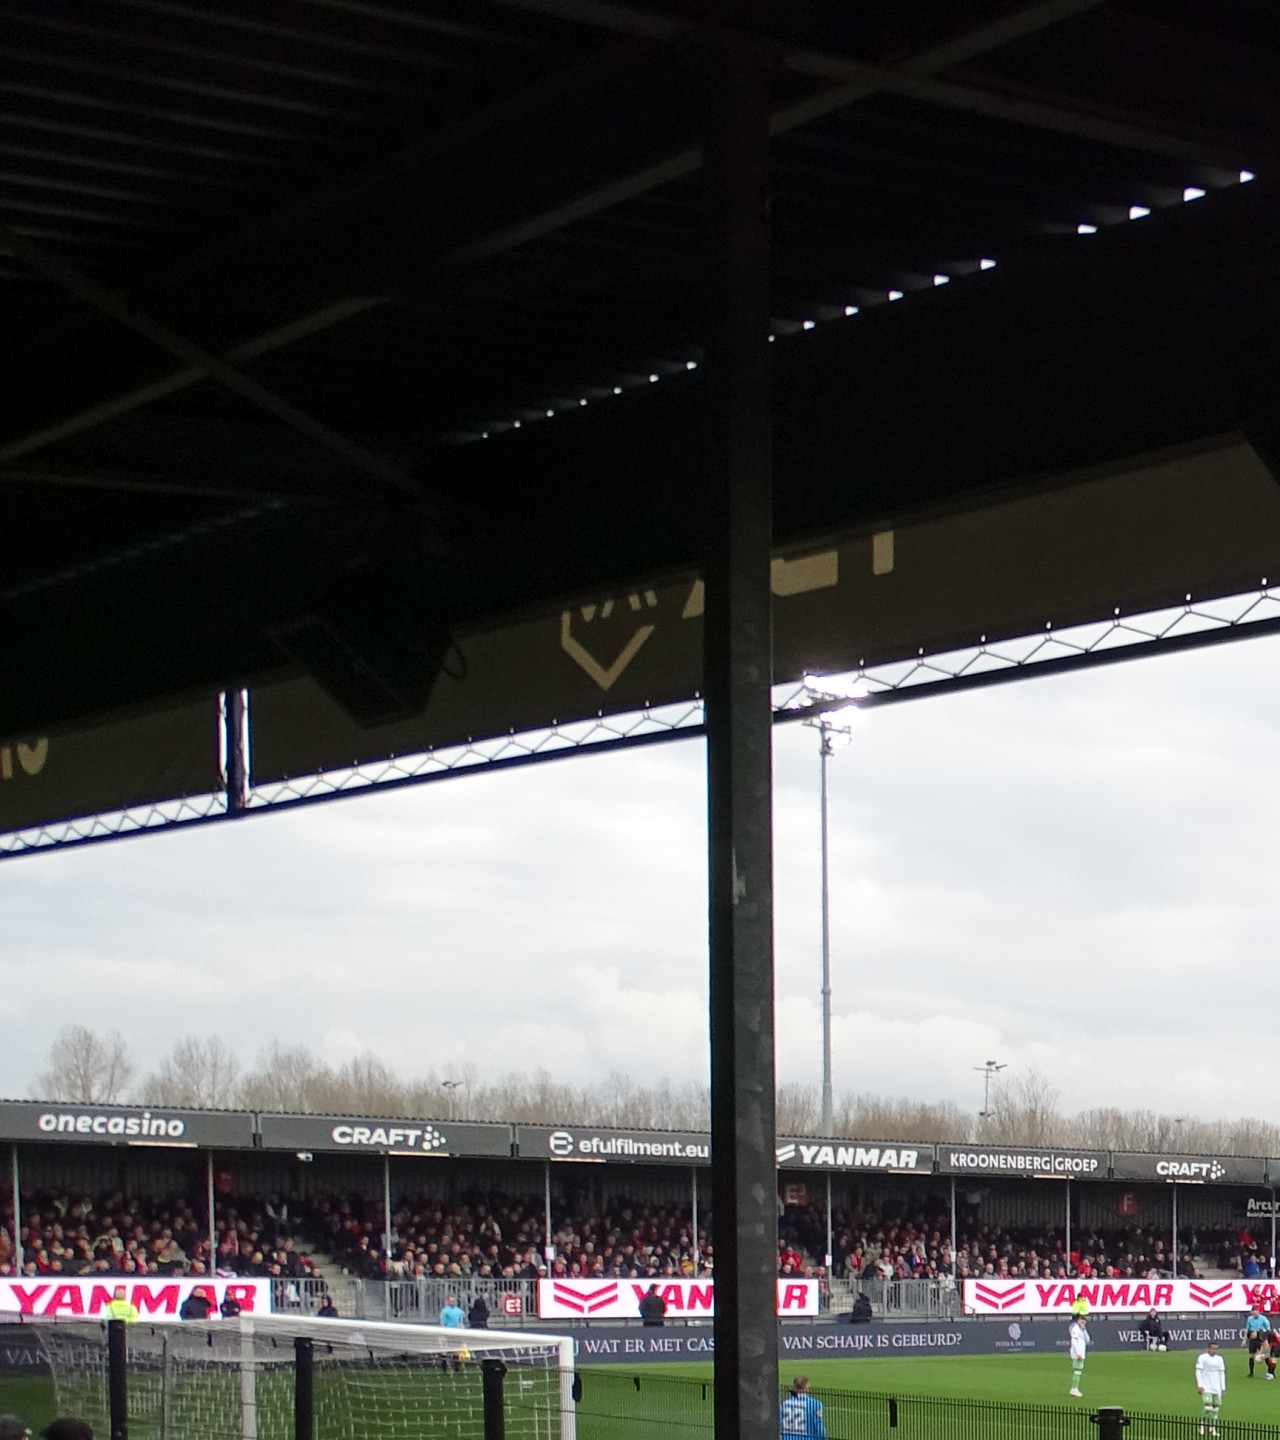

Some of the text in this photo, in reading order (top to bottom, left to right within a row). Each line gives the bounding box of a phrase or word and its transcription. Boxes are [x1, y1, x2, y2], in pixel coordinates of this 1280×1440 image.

[37, 1112, 185, 1138] onecasino
[331, 1125, 422, 1148] CRAFT
[578, 1138, 710, 1160] efulfilment.eu
[798, 1144, 919, 1169] YANMAR
[1156, 1160, 1211, 1177] CRAFT
[1035, 1284, 1174, 1307] YANMAR
[585, 1339, 620, 1354] WAT
[625, 1339, 645, 1353] ER
[650, 1338, 683, 1352] MET
[783, 1335, 813, 1350] VAN
[816, 1334, 874, 1351] SCHAIJK
[876, 1334, 890, 1348] IS
[892, 1333, 962, 1348] GEBEURD?
[1118, 1329, 1145, 1343] WEE
[1168, 1328, 1195, 1342] WAT
[1197, 1328, 1212, 1341] ER
[1214, 1328, 1237, 1341] MET
[781, 1408, 807, 1431] 22
